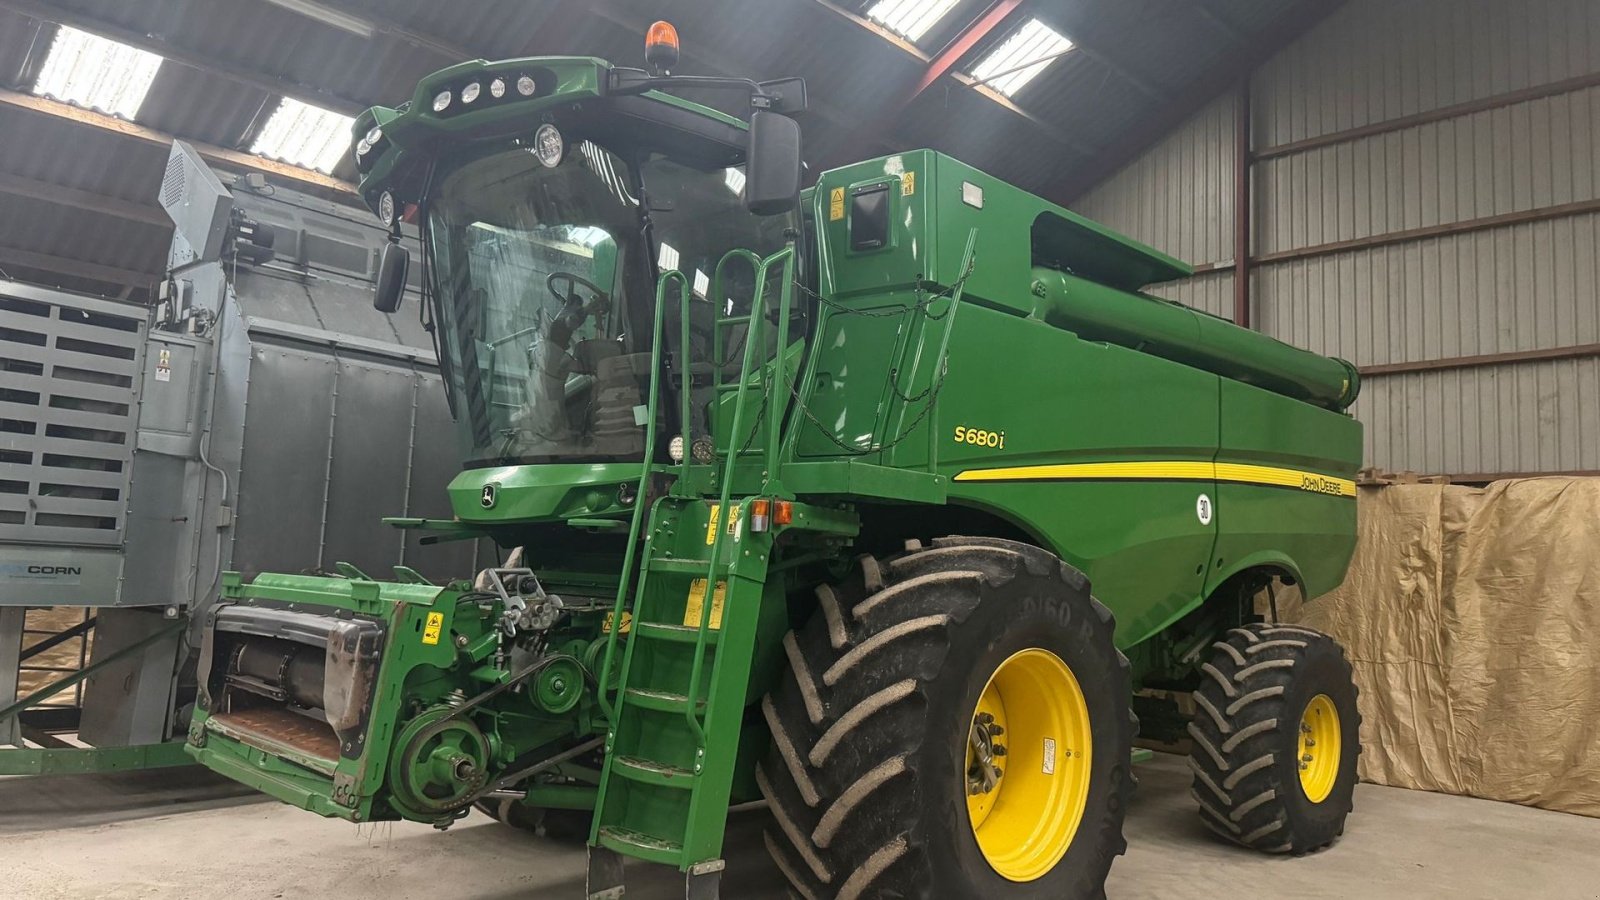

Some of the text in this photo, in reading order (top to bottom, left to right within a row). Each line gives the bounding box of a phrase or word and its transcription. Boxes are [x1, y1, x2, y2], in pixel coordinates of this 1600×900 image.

[954, 426, 1004, 450] S680i
[1200, 499, 1209, 519] 30
[28, 565, 81, 575] CORN
